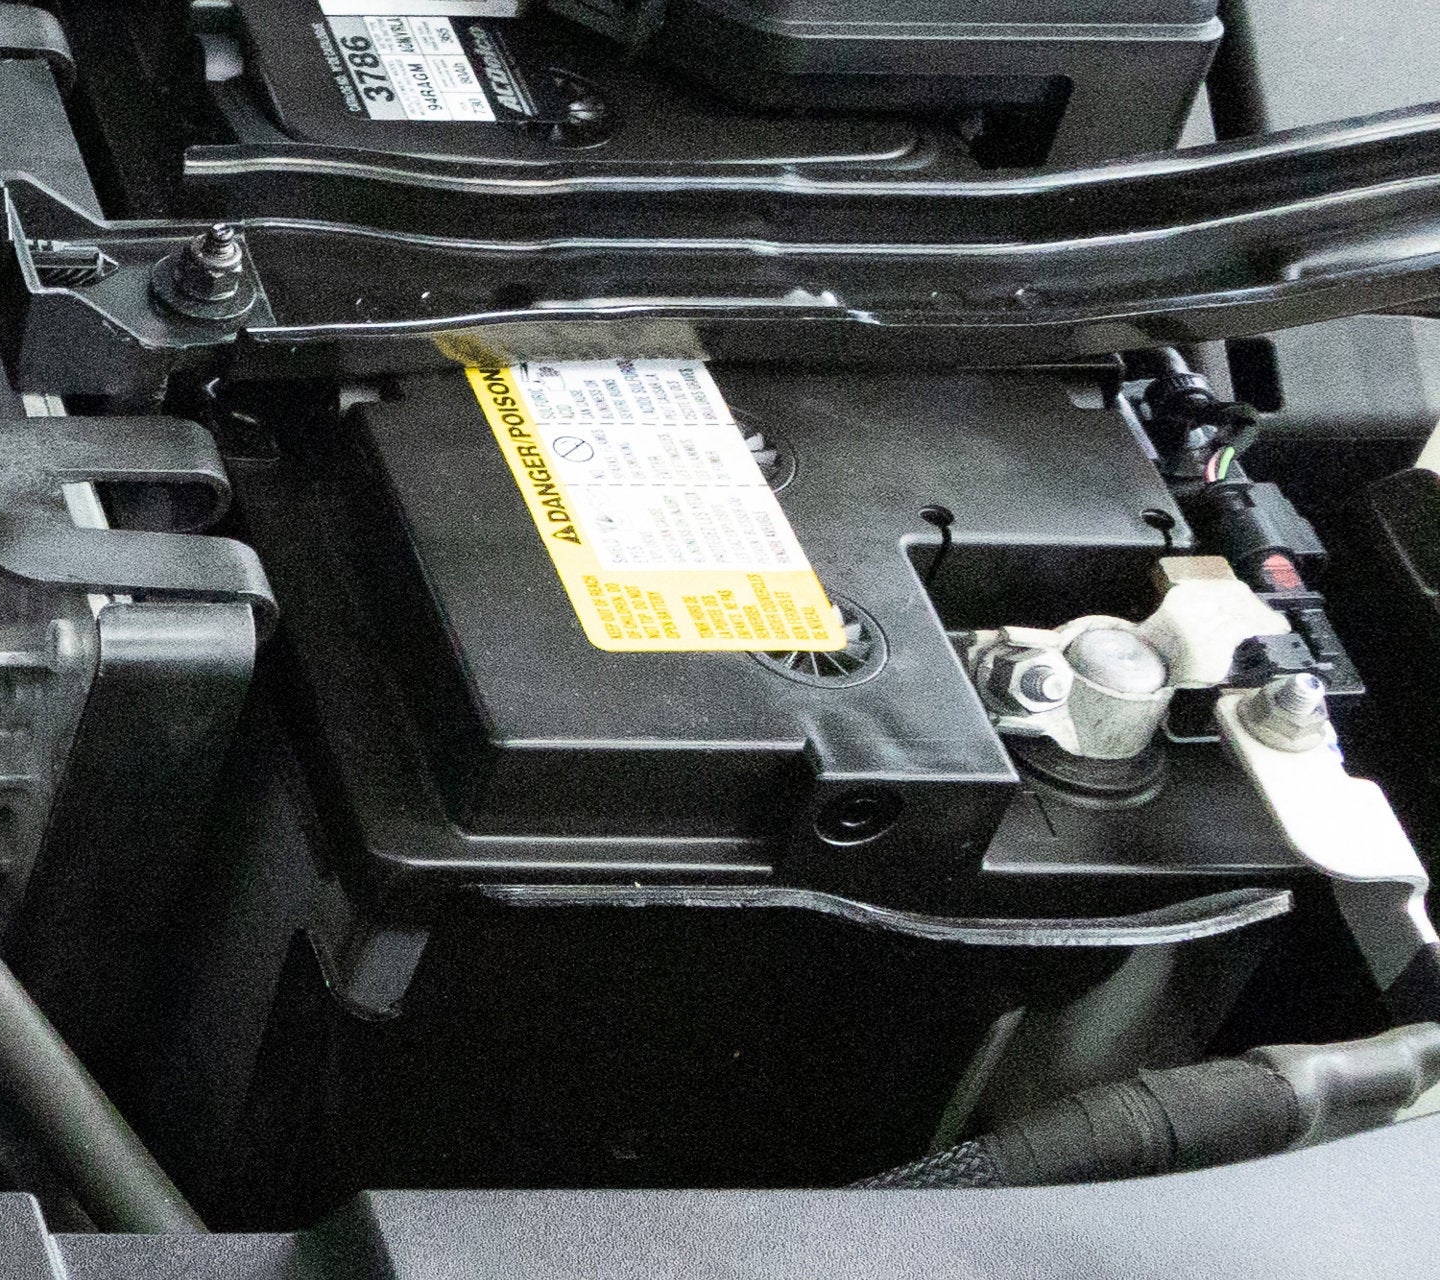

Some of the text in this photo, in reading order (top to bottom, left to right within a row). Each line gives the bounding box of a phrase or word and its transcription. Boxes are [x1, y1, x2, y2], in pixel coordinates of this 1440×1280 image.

[339, 36, 396, 101] 3786
[407, 63, 442, 110] 94RAGM
[467, 26, 522, 111] ACDelco
[479, 368, 571, 522] DANGER/POISON
